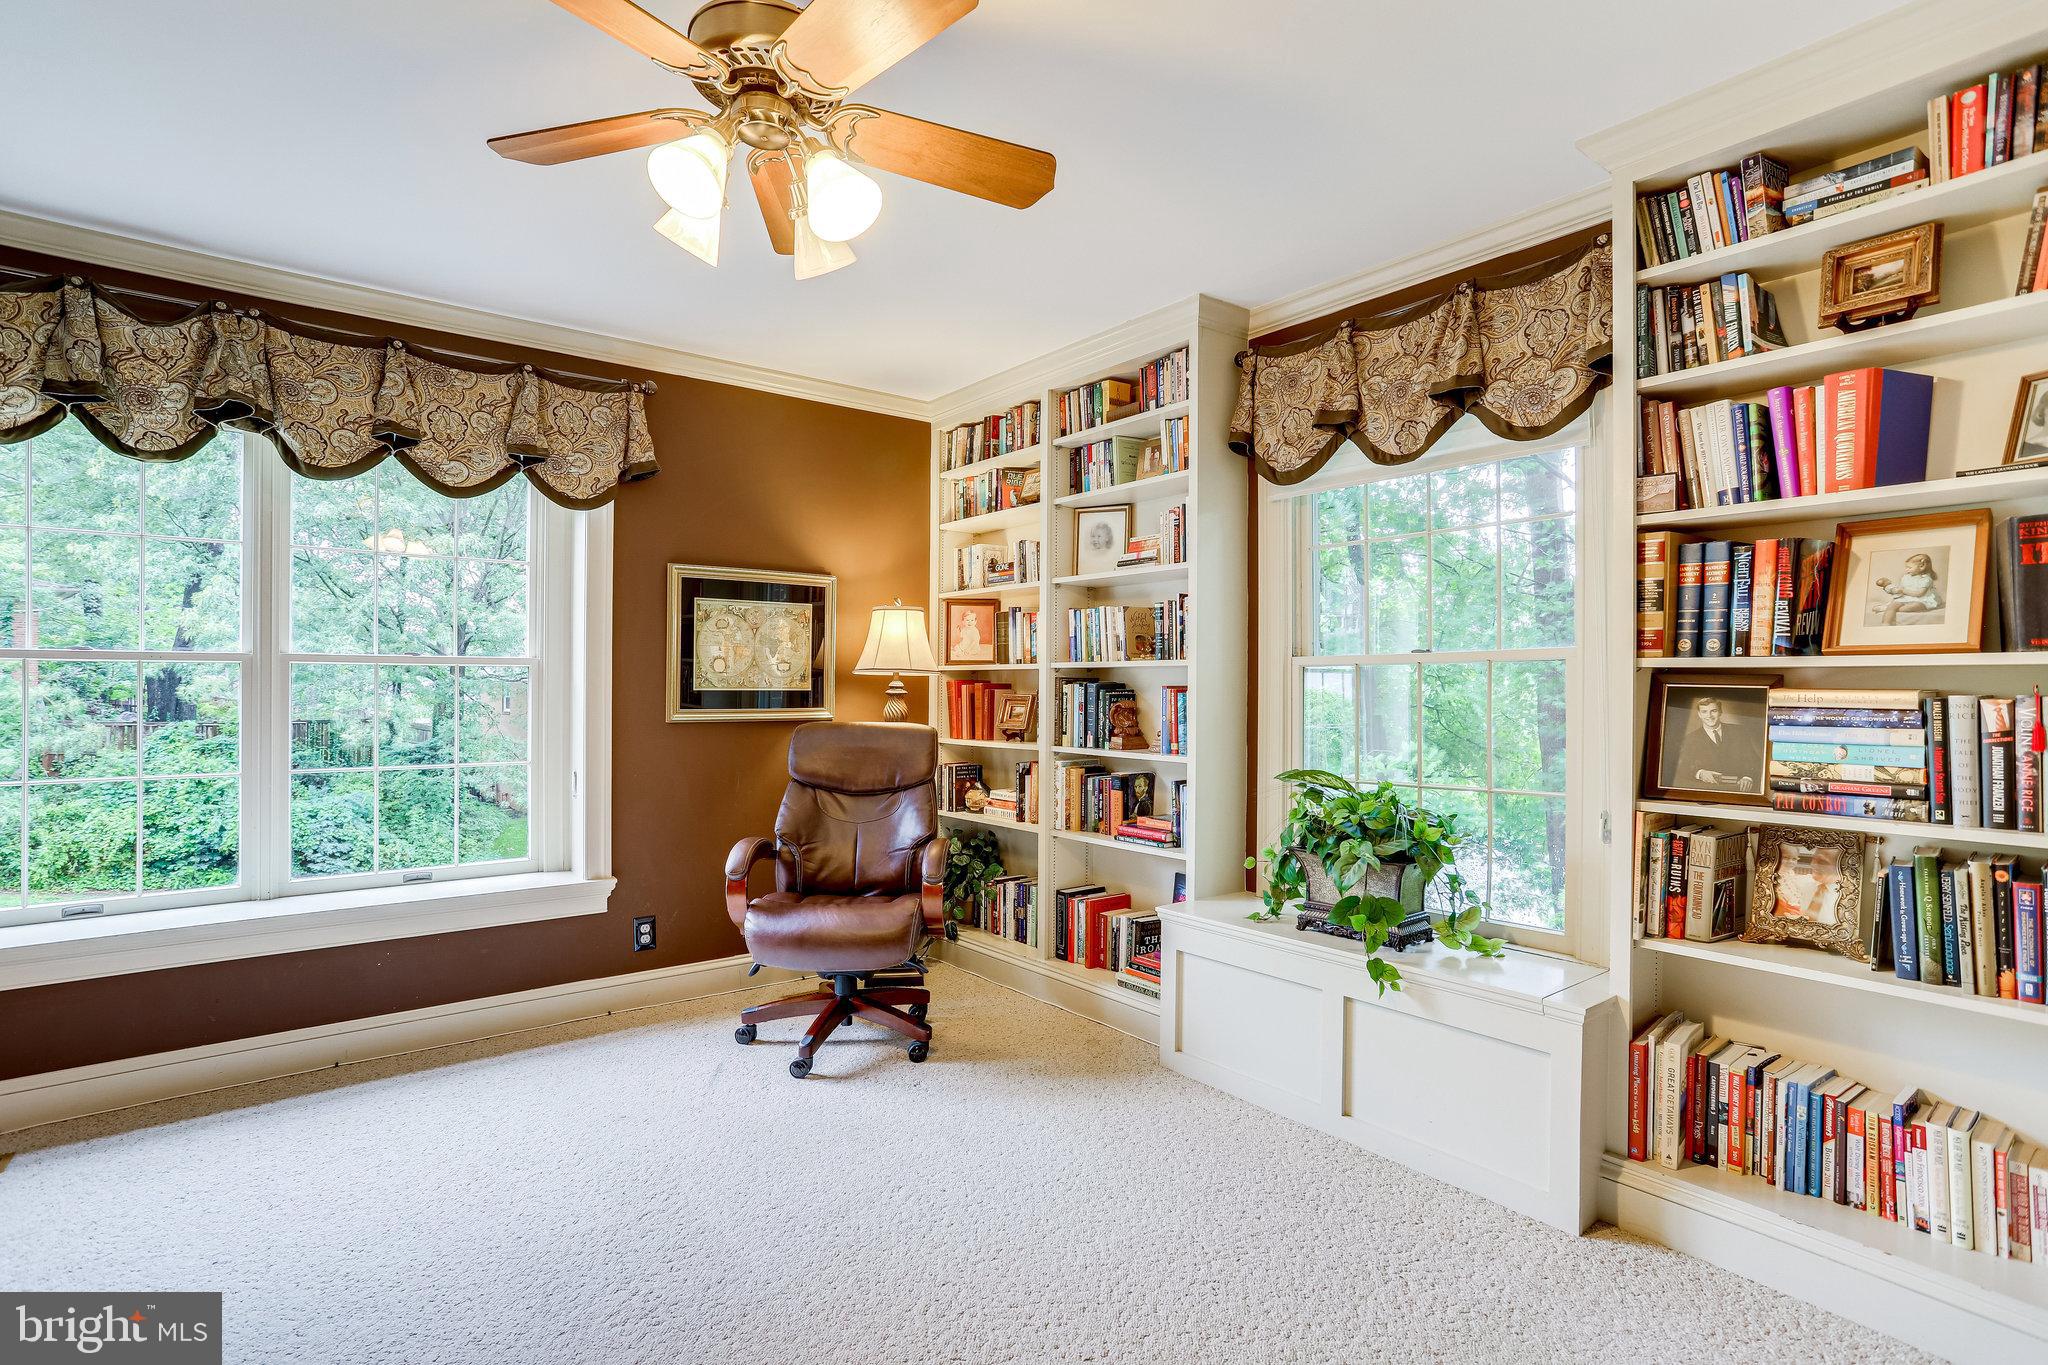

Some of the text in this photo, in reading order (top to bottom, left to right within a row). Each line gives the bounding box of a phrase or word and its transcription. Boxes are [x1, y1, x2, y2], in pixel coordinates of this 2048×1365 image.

[1828, 195, 1846, 203] FRIEND
[1865, 184, 1883, 192] FAMILY
[1693, 290, 1701, 304] LISA
[1726, 323, 1739, 352] FRANZEN
[1834, 390, 1856, 480] AMERICAN QUOTATIONS
[995, 563, 1009, 571] GONE
[1778, 547, 1793, 598] STEPHEN KING
[1775, 600, 1791, 637] REVIVAL
[1796, 694, 1824, 704] Help
[1991, 746, 2005, 811] JONATHAN FRANZEN
[2021, 756, 2034, 812] ANNE RICE
[1861, 786, 1890, 794] GREENE
[1775, 793, 1848, 813] PAT CONROY
[1691, 840, 1712, 854] AYN
[1690, 852, 1712, 866] RAND
[1669, 864, 1682, 893] RUINS
[1693, 871, 1704, 880] THE
[1940, 874, 1952, 894] JERRY
[1899, 882, 1907, 909] Homework
[1943, 894, 1954, 923] SEINFELD
[1958, 916, 1968, 938] Missing
[1140, 945, 1161, 954] ROA
[1960, 940, 1971, 955] Piece
[1632, 1049, 1640, 1076] Amazing
[1634, 1076, 1642, 1095] Places
[1719, 1067, 1728, 1099] Vietnam
[1666, 1067, 1675, 1135] GREAT GETAWAYS
[1825, 1096, 1834, 1138] Frommer's
[1868, 1115, 1876, 1131] JOHN
[1694, 1121, 1703, 1140] Dogs
[1855, 1139, 1863, 1154] Walt
[1868, 1134, 1878, 1161] GRISHAM
[1825, 1147, 1833, 1172] Boston
[1854, 1155, 1862, 1171] Disney
[1916, 1163, 1925, 1193] Francisco
